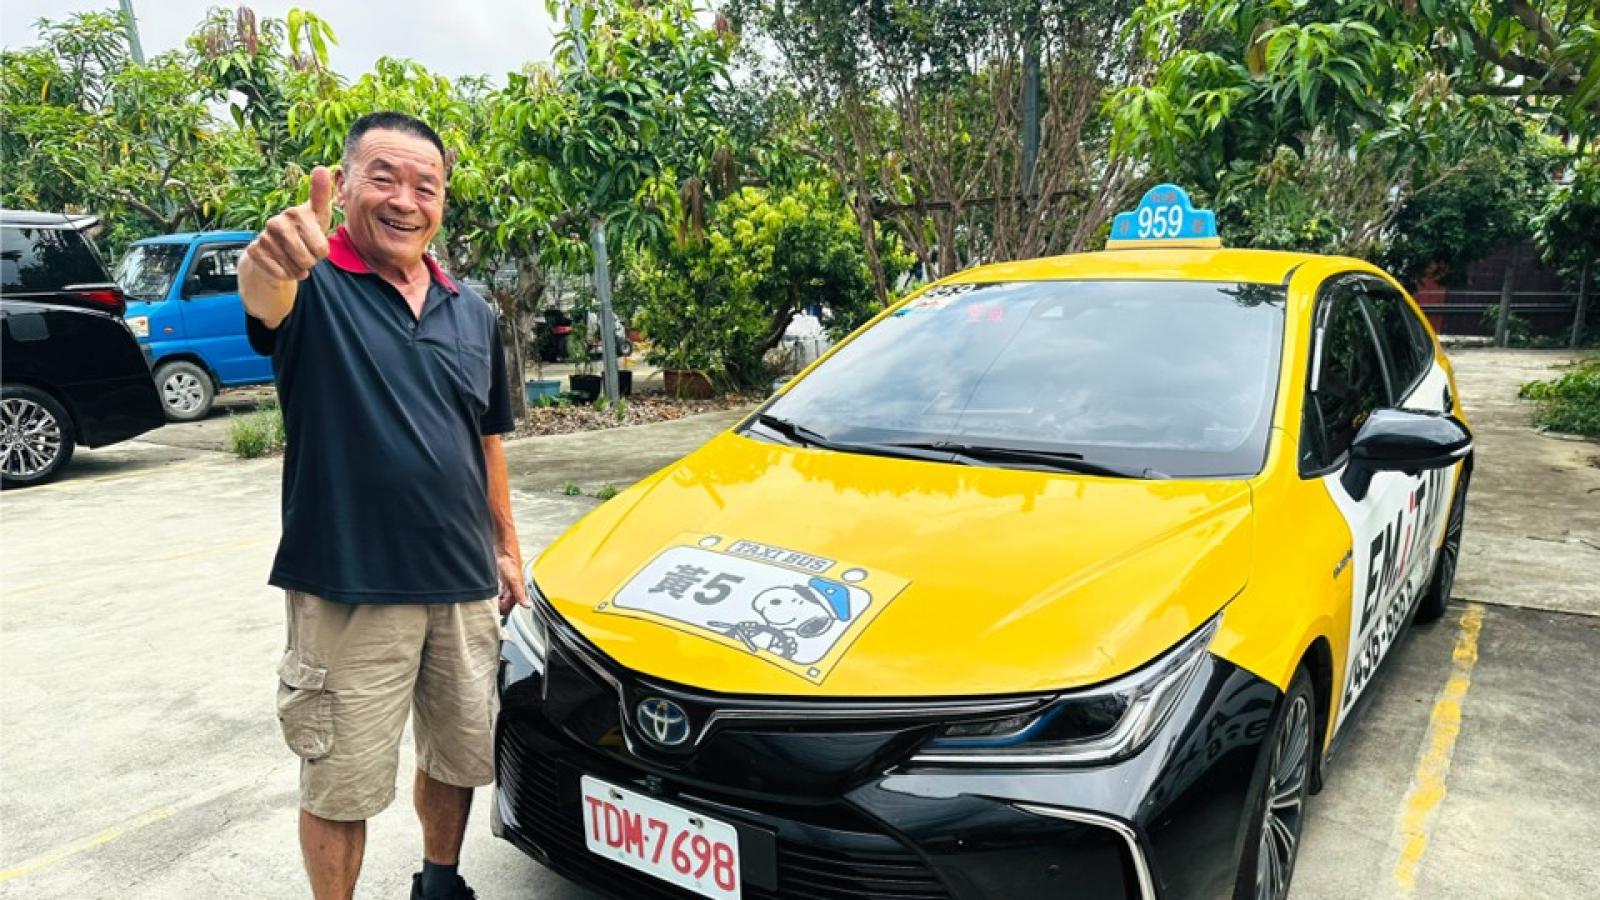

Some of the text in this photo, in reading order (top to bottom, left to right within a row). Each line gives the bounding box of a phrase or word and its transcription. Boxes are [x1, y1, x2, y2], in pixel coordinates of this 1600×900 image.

[1137, 204, 1184, 239] 959
[735, 541, 828, 570] TAXI BUS
[585, 795, 736, 892] TDM-7698
